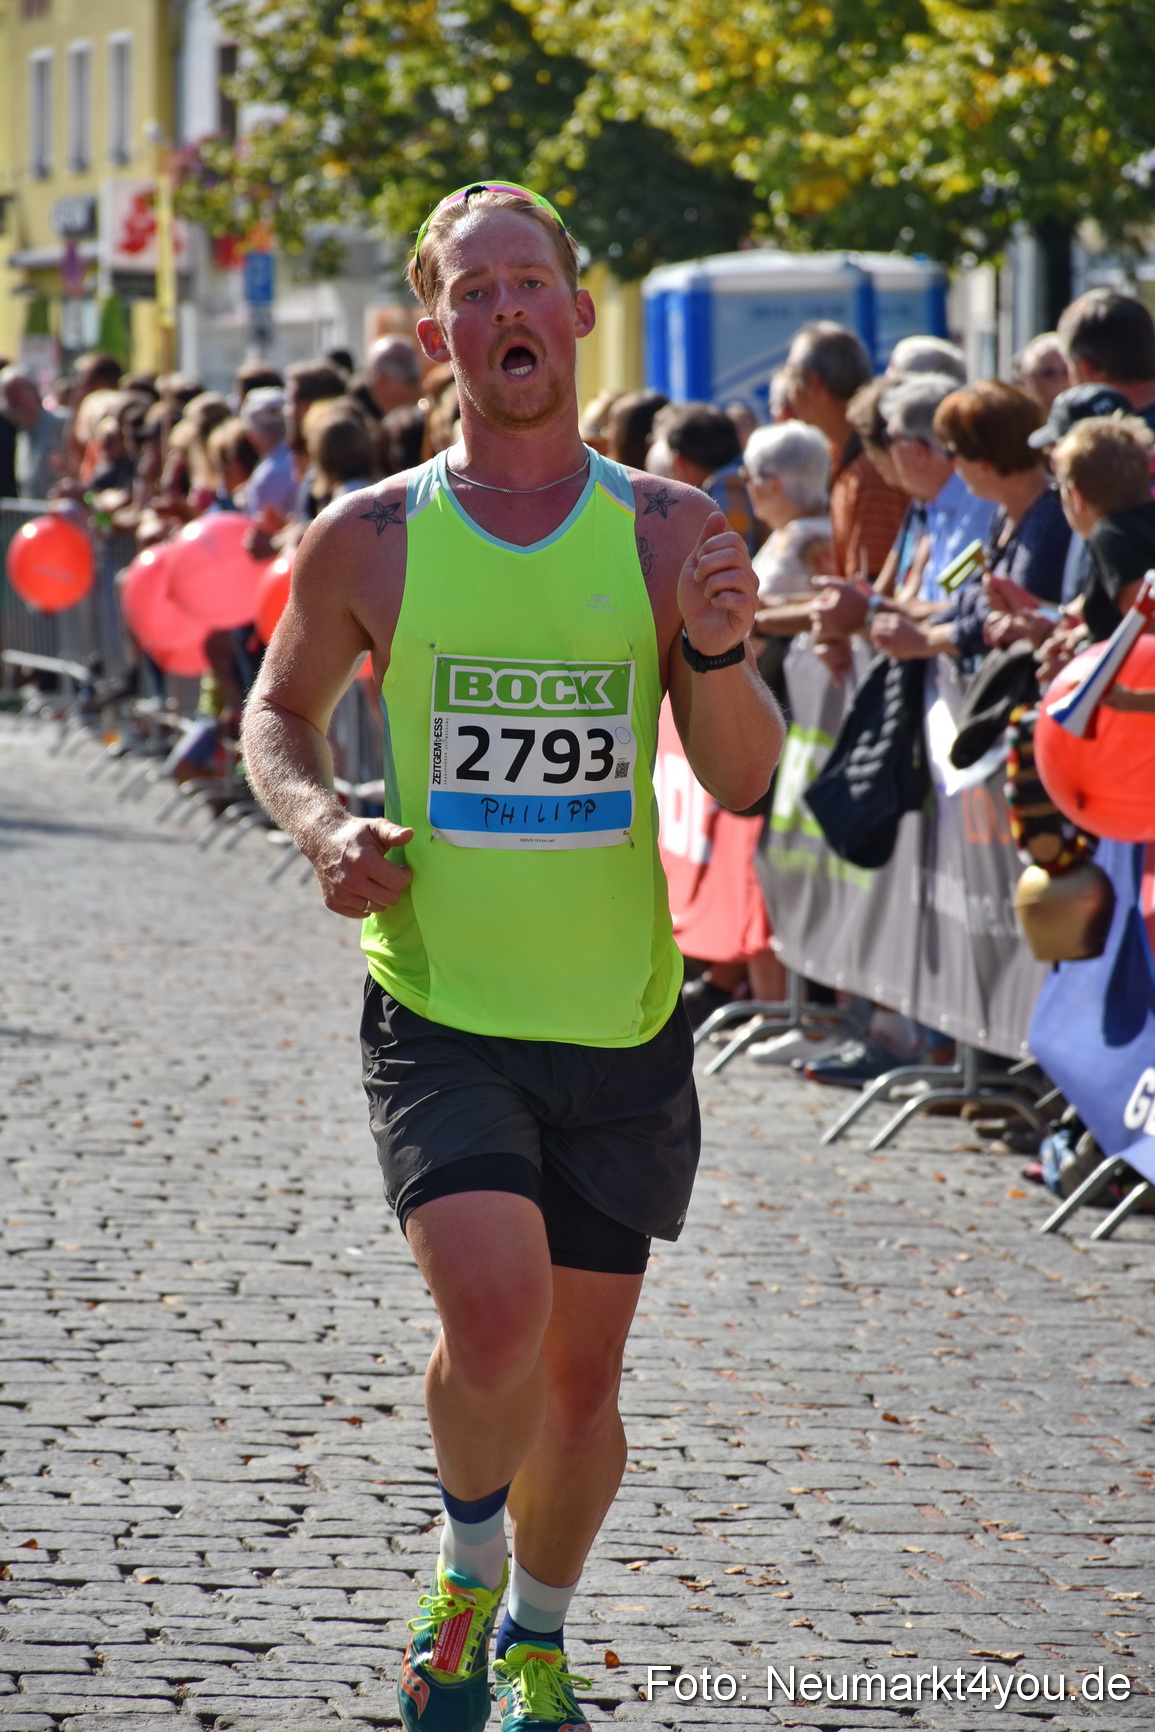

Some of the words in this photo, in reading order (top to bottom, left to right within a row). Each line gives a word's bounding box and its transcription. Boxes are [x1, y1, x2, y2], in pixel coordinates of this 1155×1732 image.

[449, 665, 614, 710] BOCK
[456, 725, 614, 784] 2793
[480, 797, 596, 828] PHILIPP
